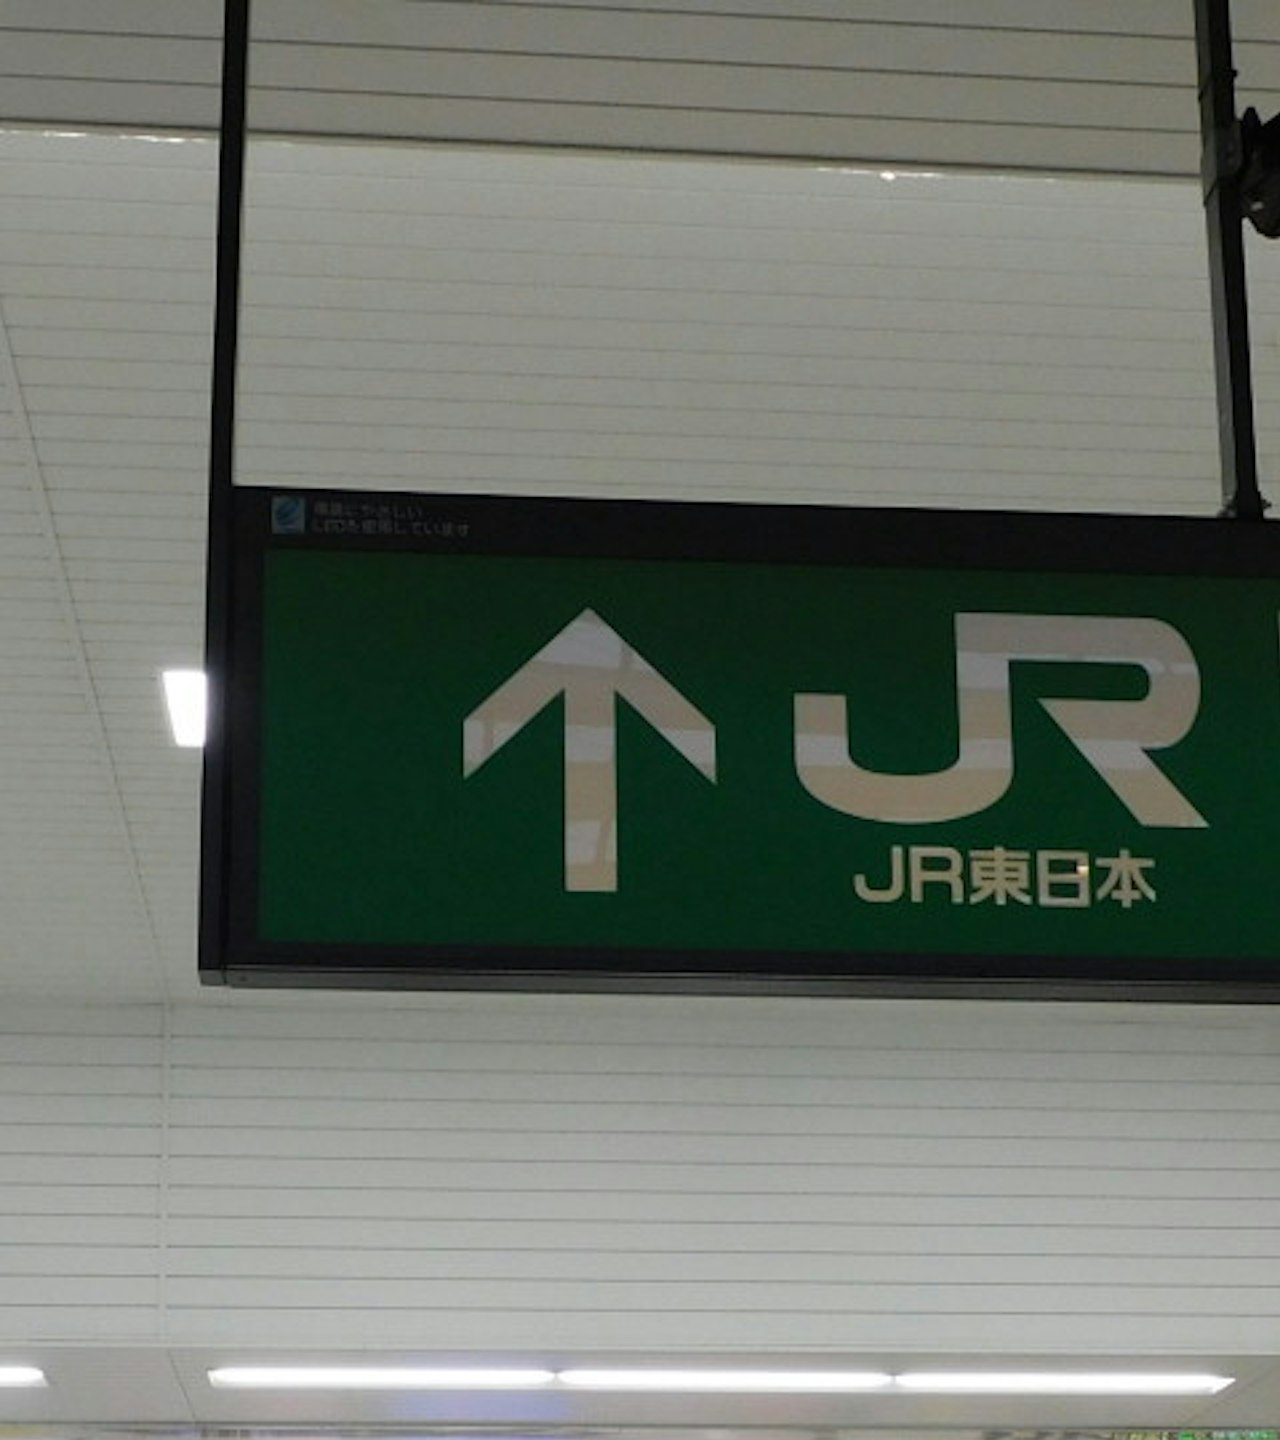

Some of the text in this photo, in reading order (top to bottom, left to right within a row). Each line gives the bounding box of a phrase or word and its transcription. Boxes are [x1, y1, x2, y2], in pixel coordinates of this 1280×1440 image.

[793, 611, 1210, 829] JR
[853, 845, 1157, 909] JR東日本
